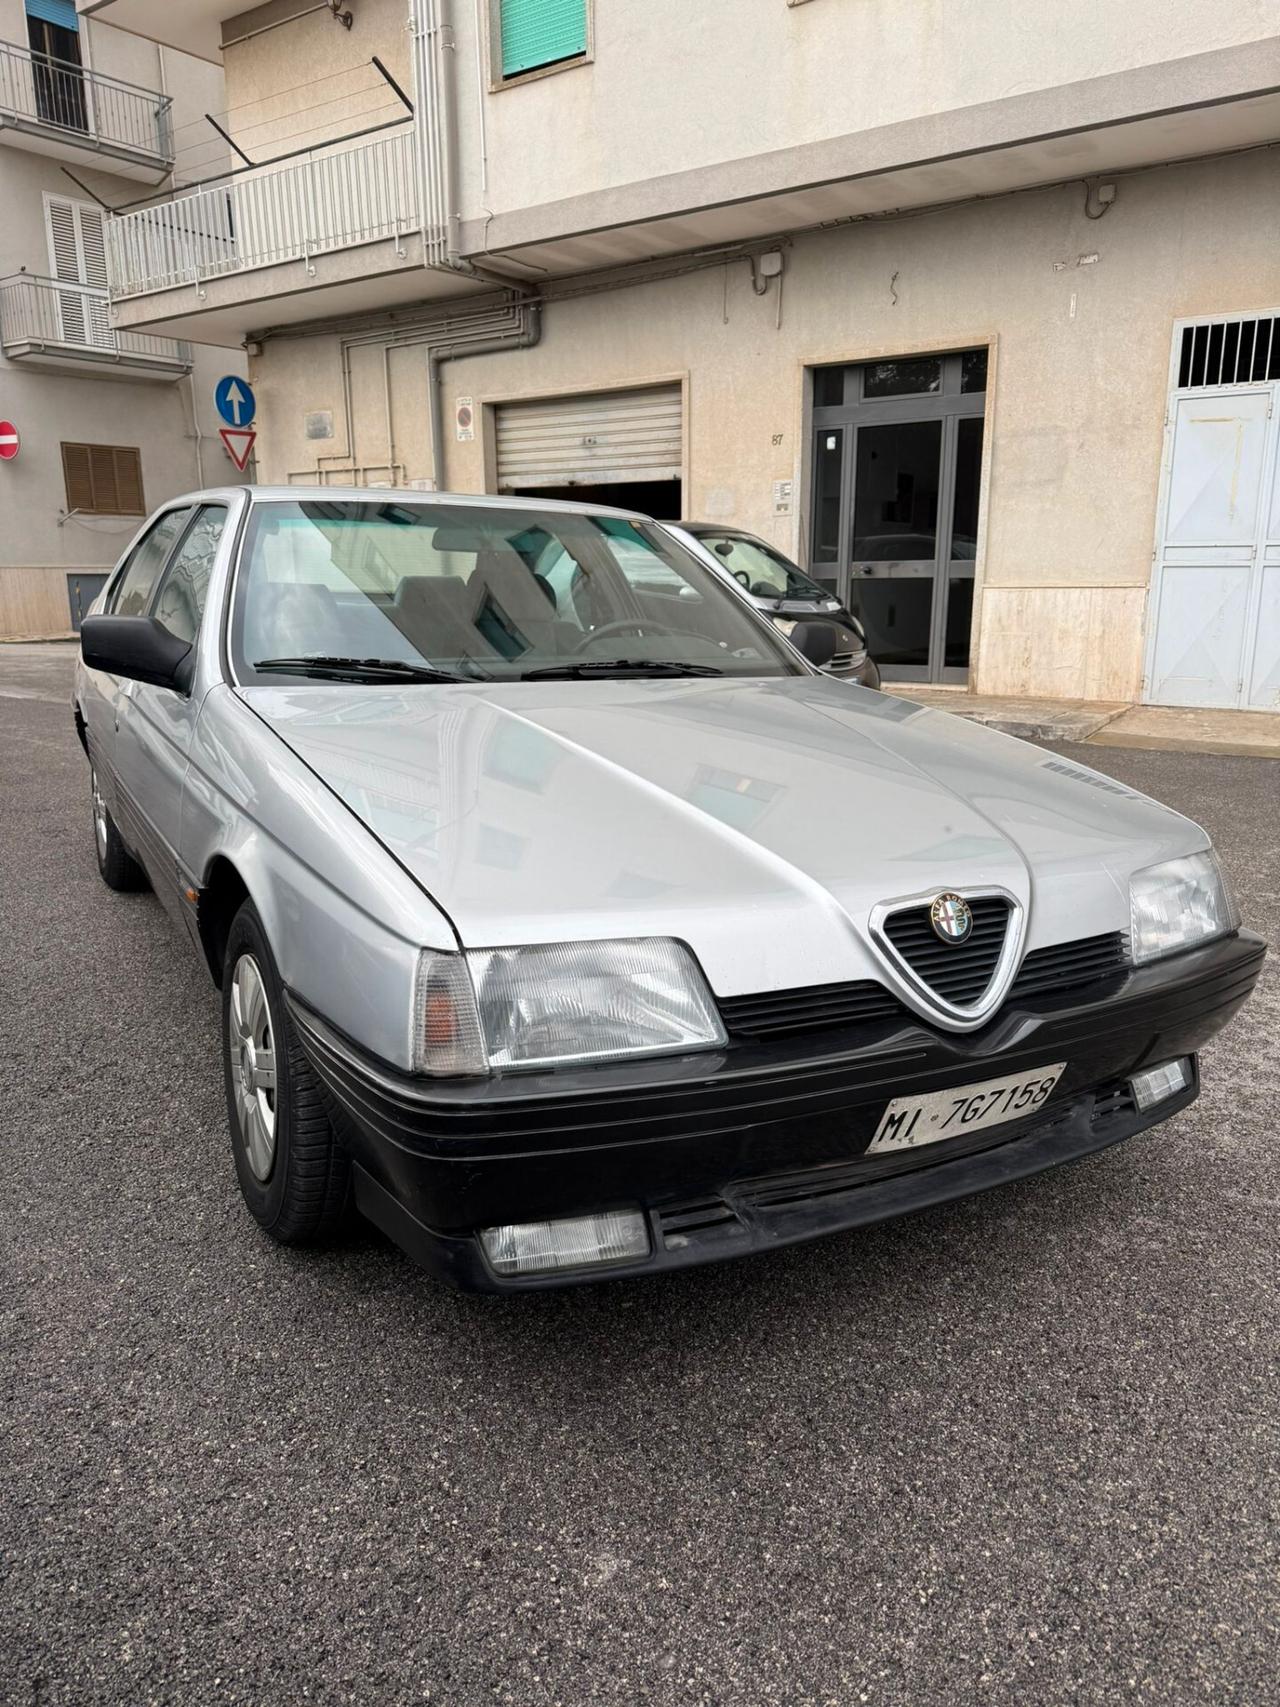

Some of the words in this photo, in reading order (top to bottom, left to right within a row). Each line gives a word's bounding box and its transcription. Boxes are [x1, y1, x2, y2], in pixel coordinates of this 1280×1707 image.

[772, 433, 783, 446] 87
[878, 1108, 922, 1142] MI
[939, 1076, 1056, 1129] 7G7158
